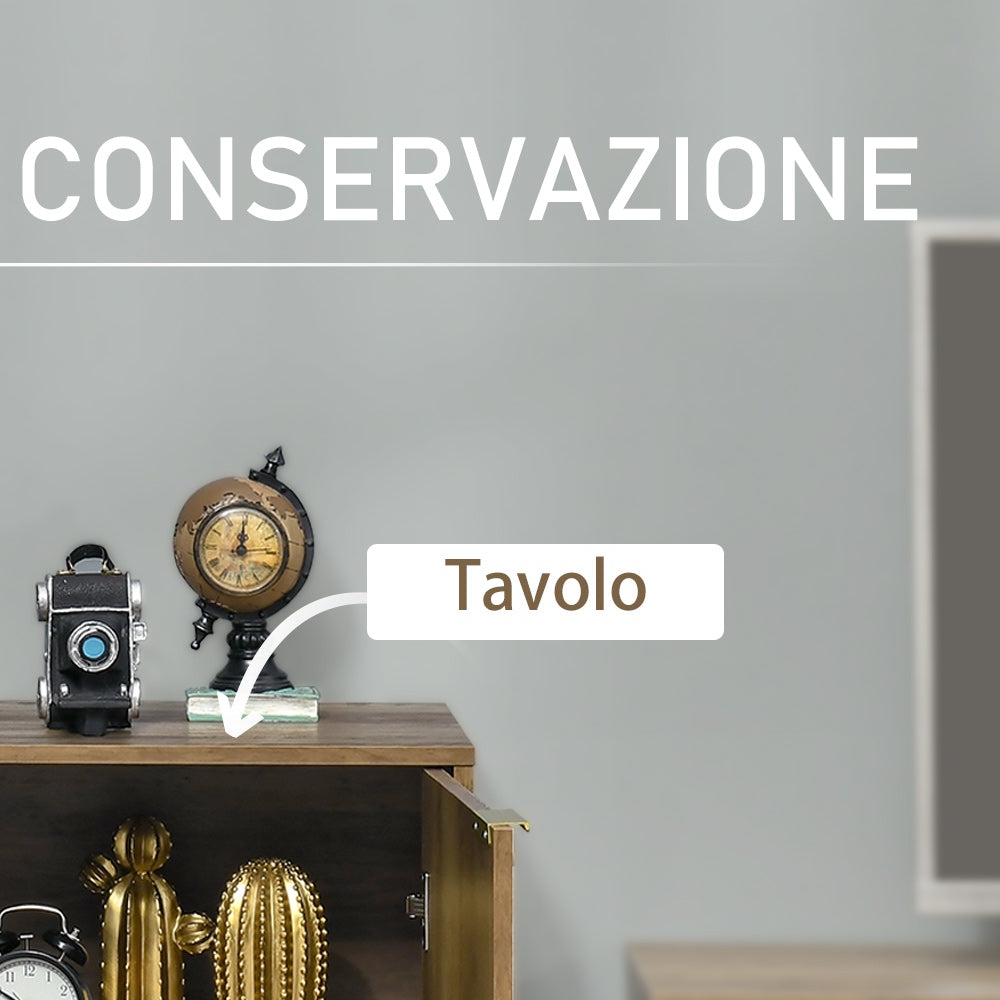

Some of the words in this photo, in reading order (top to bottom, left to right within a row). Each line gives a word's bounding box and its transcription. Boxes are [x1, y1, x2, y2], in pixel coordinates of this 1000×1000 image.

[6, 971, 15, 982] 11
[23, 965, 36, 977] 12
[60, 985, 68, 997] 2
